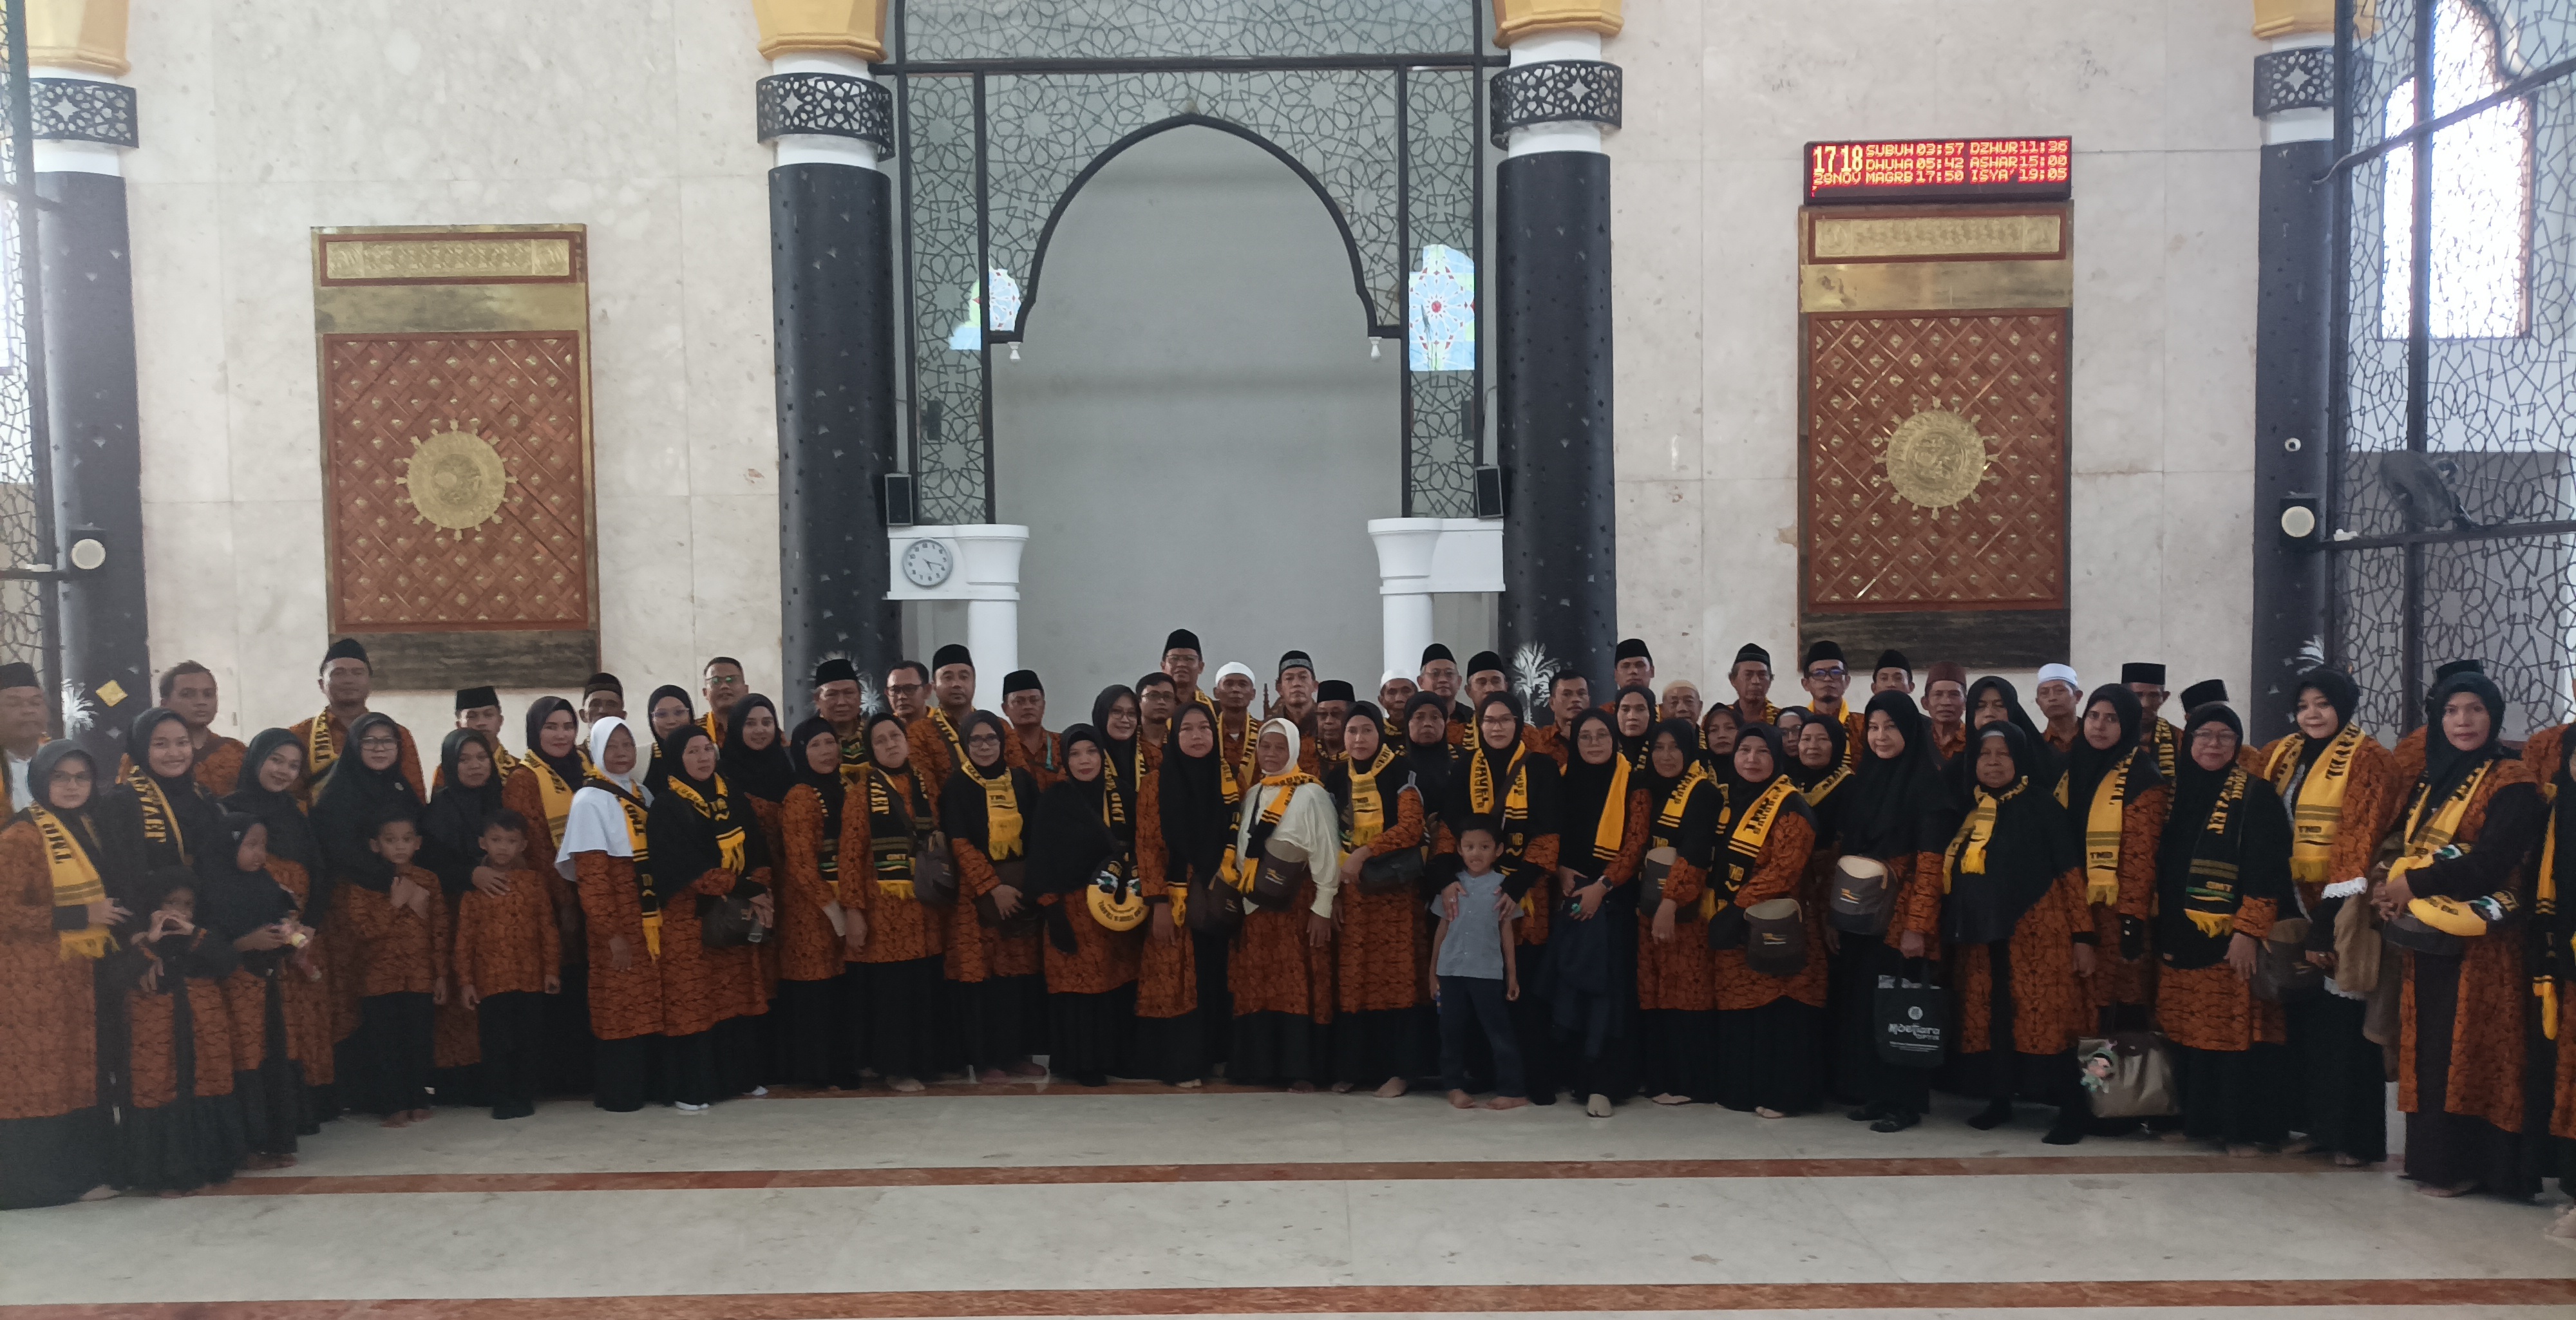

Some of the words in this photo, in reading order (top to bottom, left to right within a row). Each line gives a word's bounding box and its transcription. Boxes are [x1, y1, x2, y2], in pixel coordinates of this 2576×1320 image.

[1866, 144, 1914, 157] SUBUH
[1916, 142, 1964, 156] 03:57
[1970, 141, 2018, 155] DZHUR
[1866, 158, 1914, 171] DHUHA
[1916, 157, 1964, 171] 05:42
[1970, 156, 2018, 169] ASHAR
[2019, 155, 2068, 168] 15:00
[1865, 171, 1914, 184] MAGRB
[1915, 170, 1964, 184] 17:50
[2018, 168, 2068, 182] 19:05
